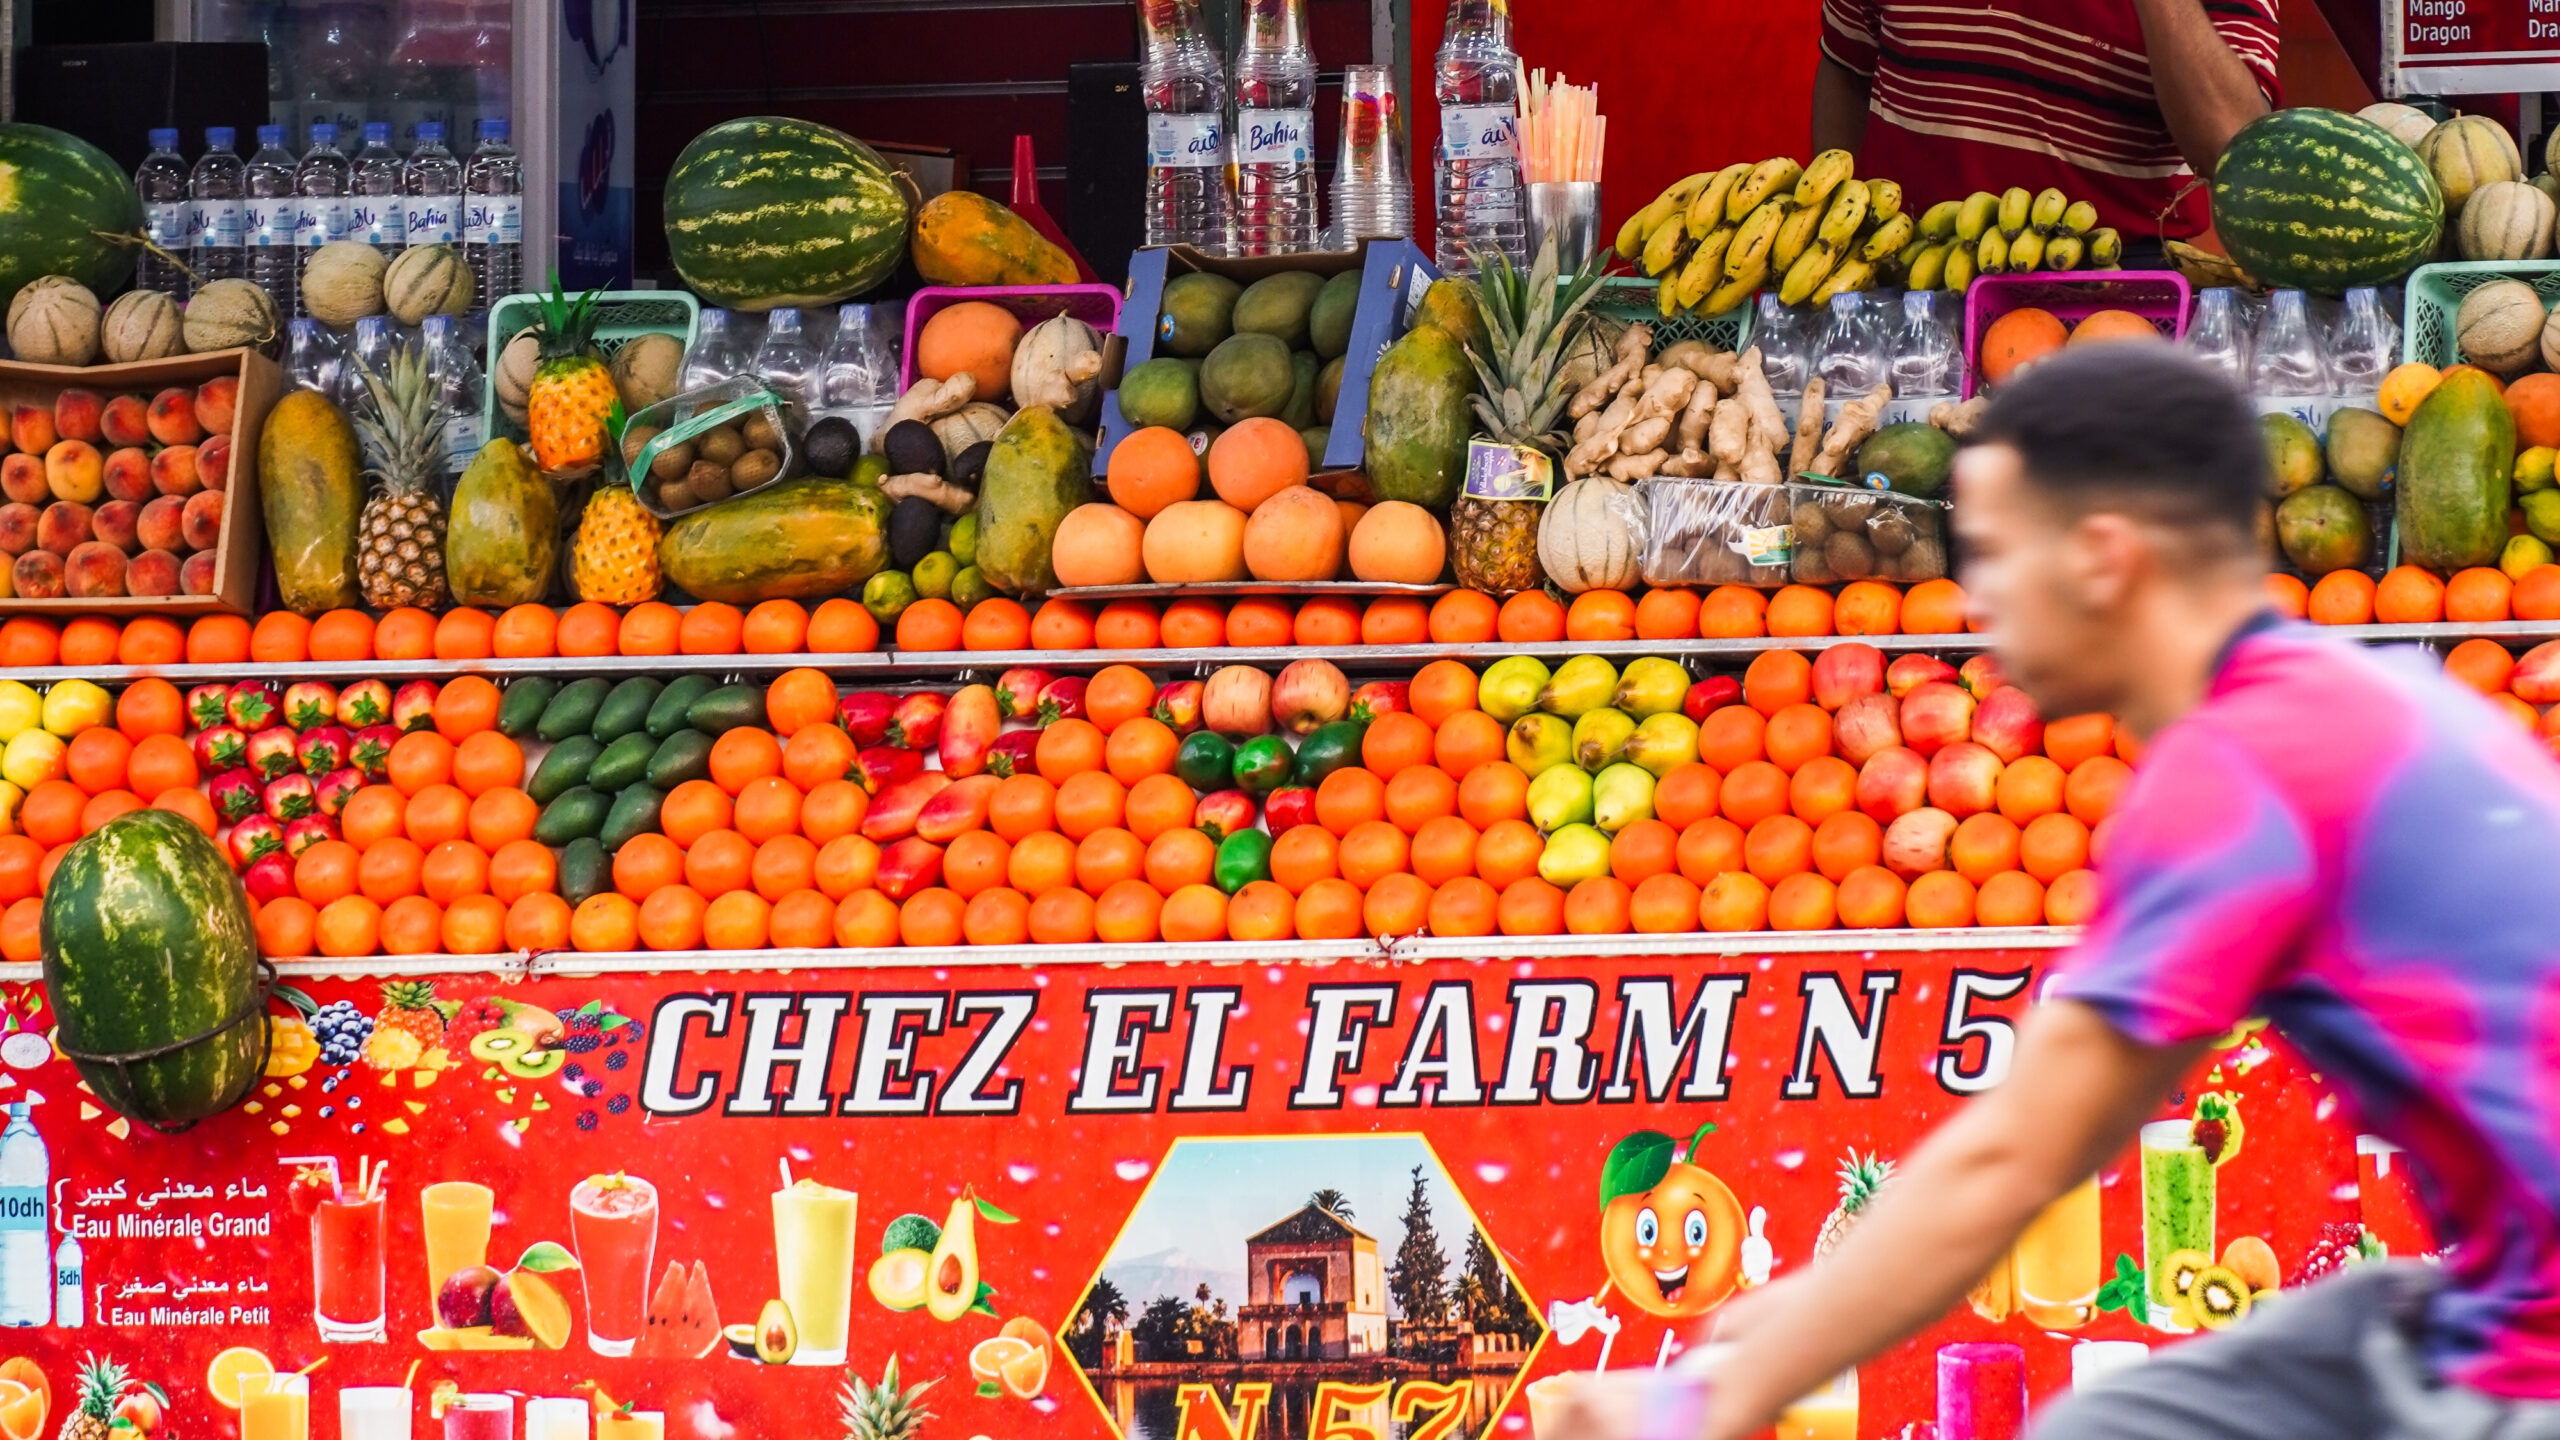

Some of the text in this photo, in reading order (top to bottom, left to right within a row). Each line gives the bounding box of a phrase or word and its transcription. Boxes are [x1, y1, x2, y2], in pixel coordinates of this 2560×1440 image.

[2409, 0, 2466, 20] Mango
[2410, 22, 2471, 46] Dragon
[2528, 18, 2560, 38] Dra
[1250, 120, 1298, 153] Bahia
[409, 207, 448, 234] Bahia
[638, 965, 2062, 1117] CHEZ EL FARM N 5
[75, 1176, 268, 1210] ماء معدني كبير
[0, 1197, 44, 1217] 10dh
[73, 1211, 270, 1238] Eau Minérale Grand
[59, 1270, 81, 1286] 5dh
[114, 1276, 268, 1300] ماء معدني صغير
[111, 1305, 270, 1326] Eau Minérale Petit
[1176, 1379, 1473, 1440] N 57
